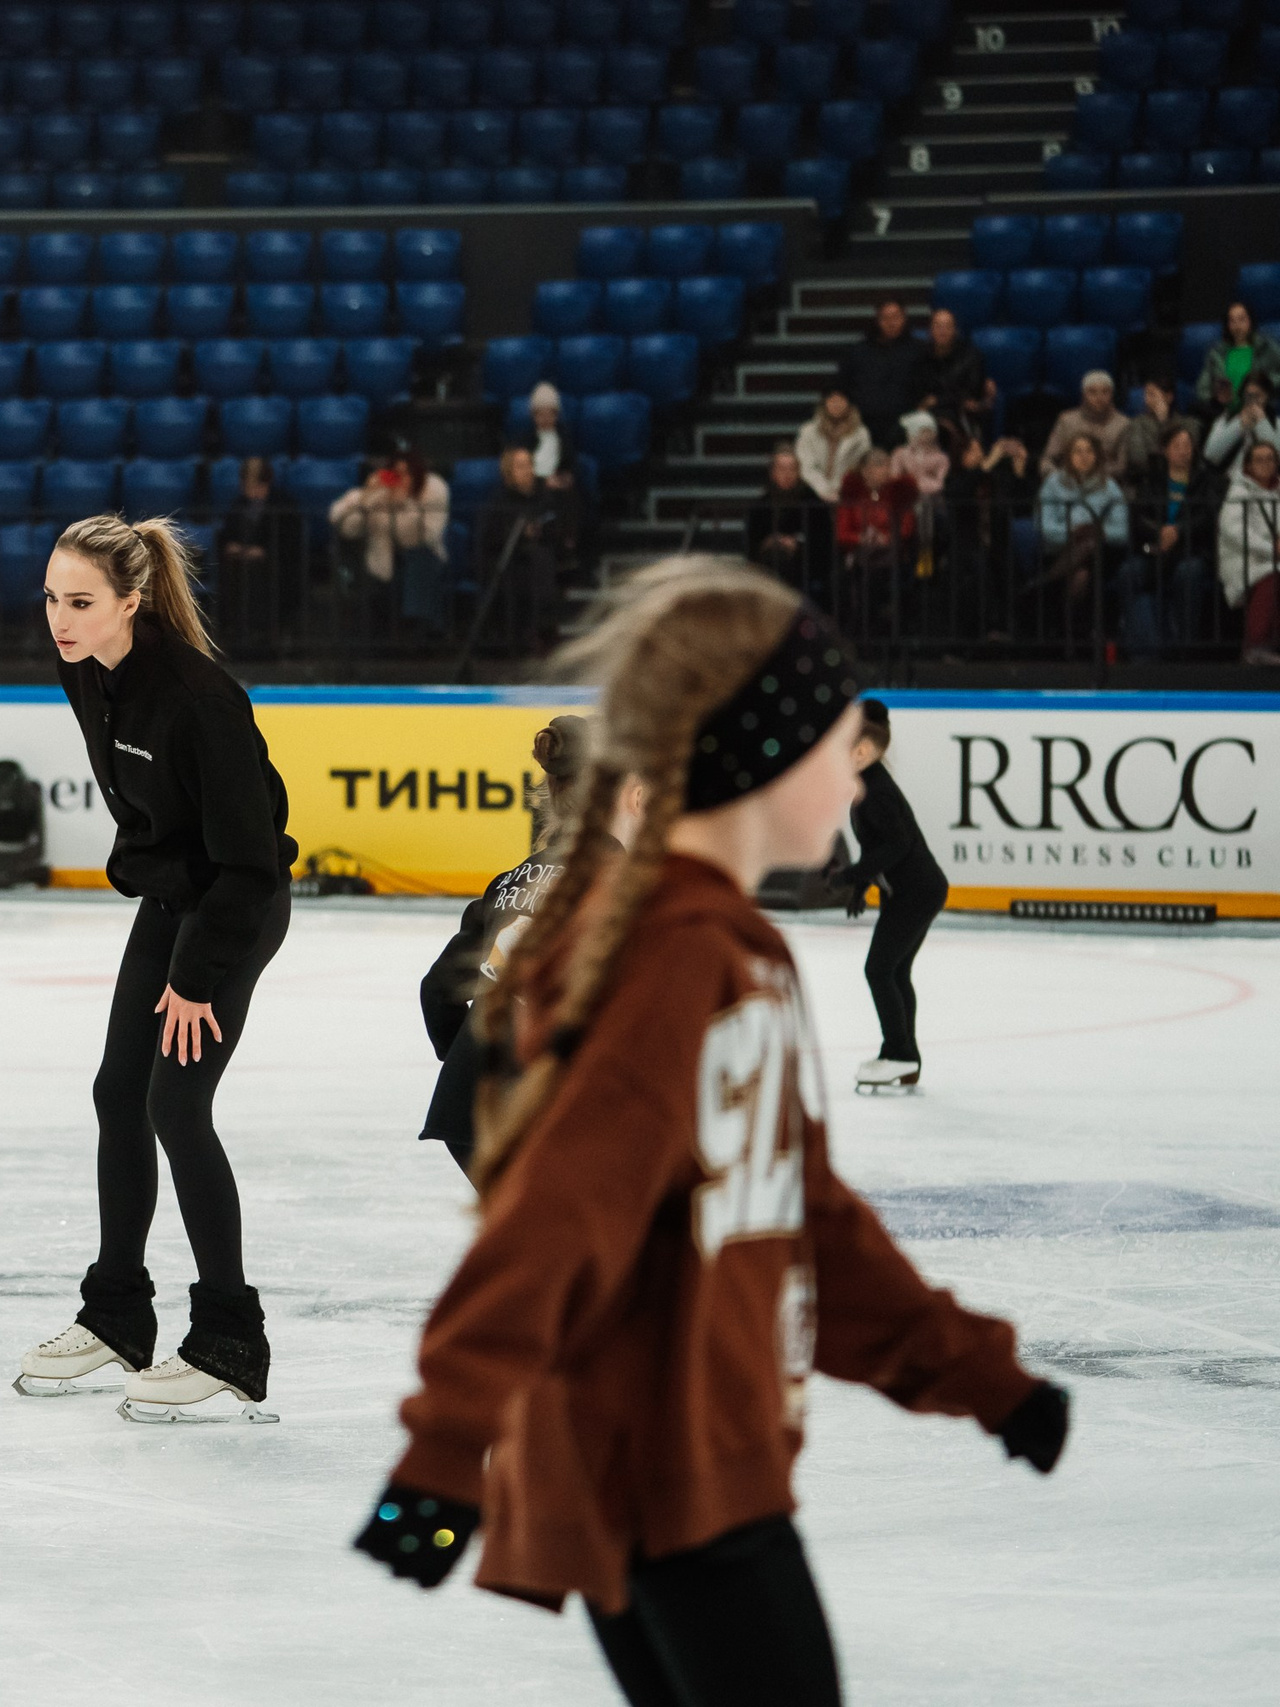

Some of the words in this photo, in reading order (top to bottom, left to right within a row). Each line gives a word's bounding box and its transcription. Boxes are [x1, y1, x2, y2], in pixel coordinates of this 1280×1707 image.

[975, 26, 1005, 51] 10
[941, 81, 963, 110] 9
[909, 143, 930, 173] 8
[872, 207, 892, 236] 7
[949, 735, 1257, 834] RRCC
[953, 842, 1137, 867] BUSINESS
[1158, 845, 1252, 868] CLUB
